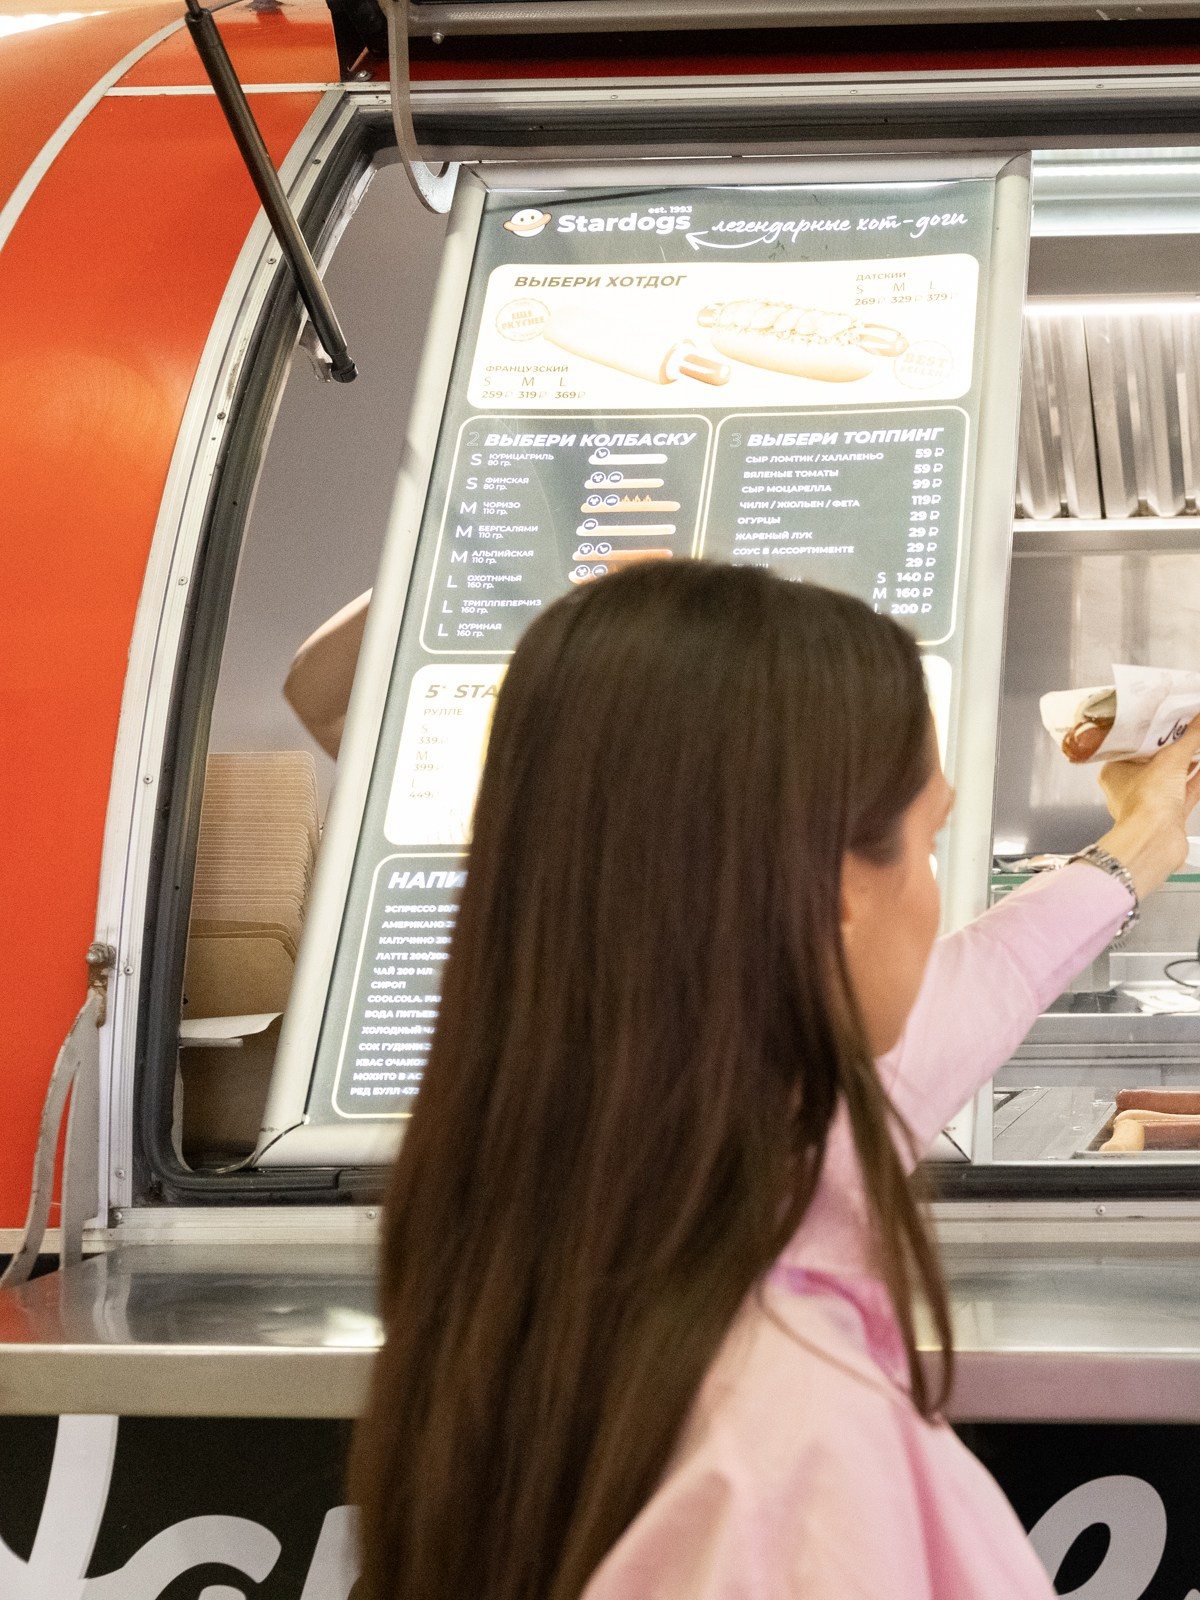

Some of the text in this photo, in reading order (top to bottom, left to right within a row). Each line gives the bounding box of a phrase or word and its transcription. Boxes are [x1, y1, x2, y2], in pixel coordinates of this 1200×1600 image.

[557, 213, 691, 235] Stardogs
[711, 217, 852, 243] легендарные
[514, 275, 688, 289] ВЫБЕРИ ХОТДОГ
[893, 281, 905, 292] M
[485, 364, 569, 374] ФРАНЦУЗСКИЙ
[521, 376, 535, 386] M
[484, 433, 577, 447] ВЫБЕРИ
[579, 432, 698, 447] КОЛБАСКУ
[747, 432, 838, 447] ВЫБЕРИ
[844, 428, 945, 445] ТОППИНГ
[470, 453, 482, 466] S
[746, 456, 768, 464] СЫР
[769, 455, 813, 463] ЛОМТИК
[821, 453, 884, 462] ХАЛАПЕНЬО
[743, 470, 793, 479] ВЯЛЕНЫЕ
[795, 469, 839, 478] ТОМАТЫ
[466, 477, 478, 490] S
[741, 485, 765, 494] СЫР
[766, 485, 832, 494] МОЦАРЕЛЛА
[460, 501, 521, 515] M ЧОРИЗО
[740, 501, 769, 509] ЧИЛИ
[777, 500, 824, 509] ЖЮЛЬЕН
[832, 499, 860, 508] ФЕТА
[737, 516, 781, 525] ОГУРЦЫ
[455, 525, 473, 539] M
[735, 531, 789, 541] ЖАРЕНЫЙ
[790, 532, 813, 540] ЛУК
[450, 549, 534, 564] M АЛЬПИЙСКАЯ
[733, 547, 761, 556] СОУС
[771, 546, 855, 555] АССОРТИМЕНТЕ
[447, 575, 458, 589] L
[876, 571, 886, 583] S
[873, 587, 887, 599] M
[442, 600, 453, 614] L
[437, 623, 449, 637] L
[454, 684, 499, 699] STA
[388, 871, 468, 889] НАПИ
[381, 920, 444, 929] АМЕРИКАНО
[375, 952, 408, 961] ЛАТТЕ
[373, 966, 395, 976] ЧАЙ
[371, 980, 407, 989] СИРОП
[364, 1010, 439, 1019] ВОДА ПИТЬЕВ
[358, 1042, 381, 1051] СОК
[353, 1072, 398, 1081] МОХИТО
